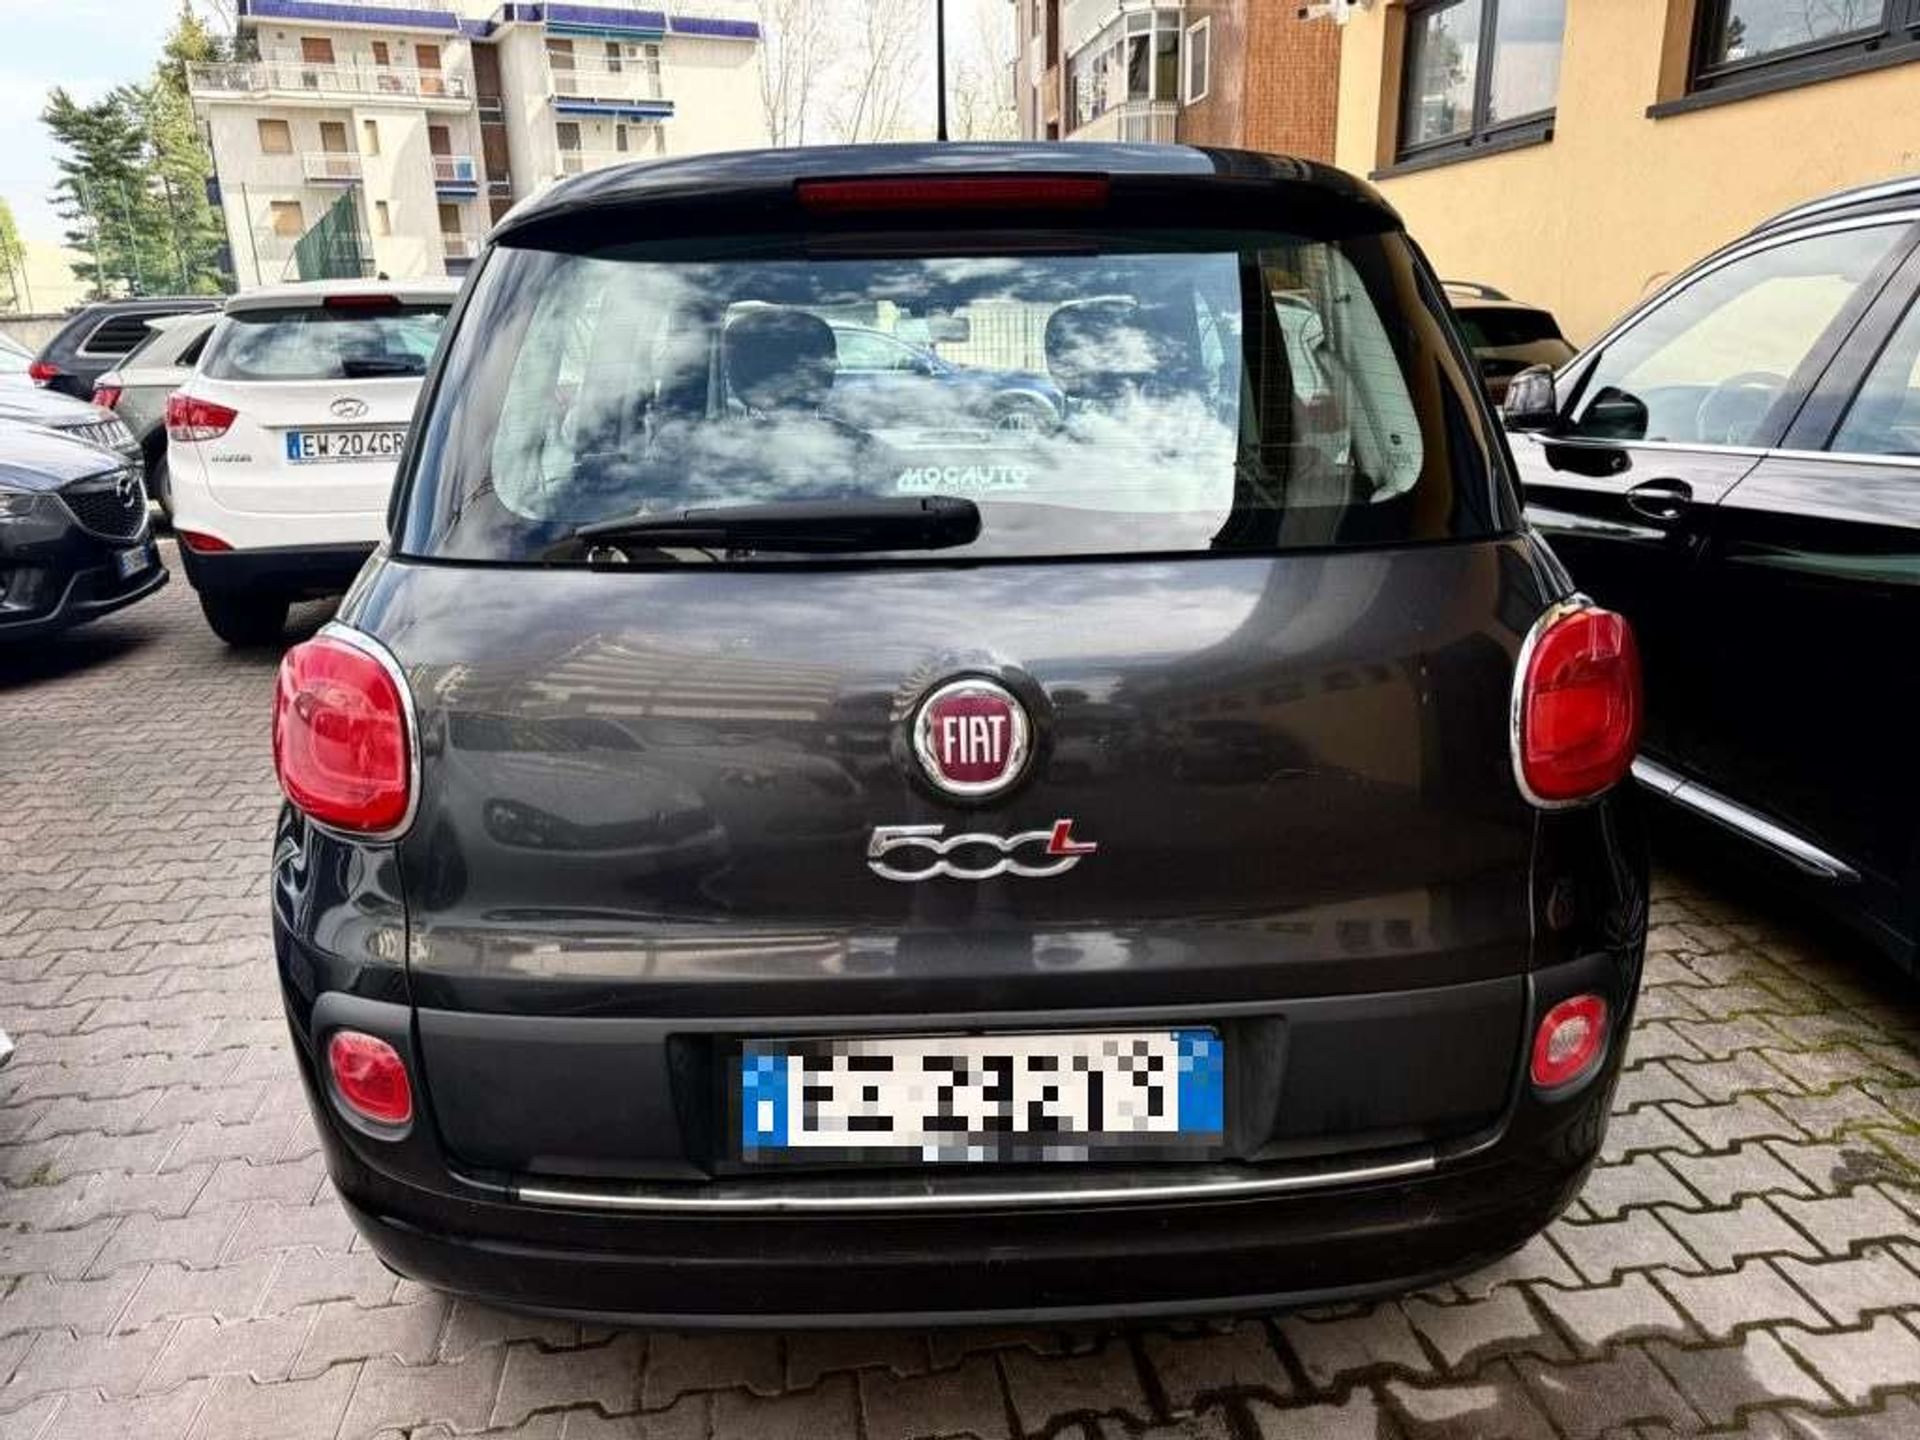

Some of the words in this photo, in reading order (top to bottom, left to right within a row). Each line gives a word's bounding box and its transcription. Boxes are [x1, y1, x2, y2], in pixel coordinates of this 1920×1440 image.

[303, 434, 329, 456] EW
[943, 716, 1006, 764] FIAT
[867, 819, 1097, 881] 500L
